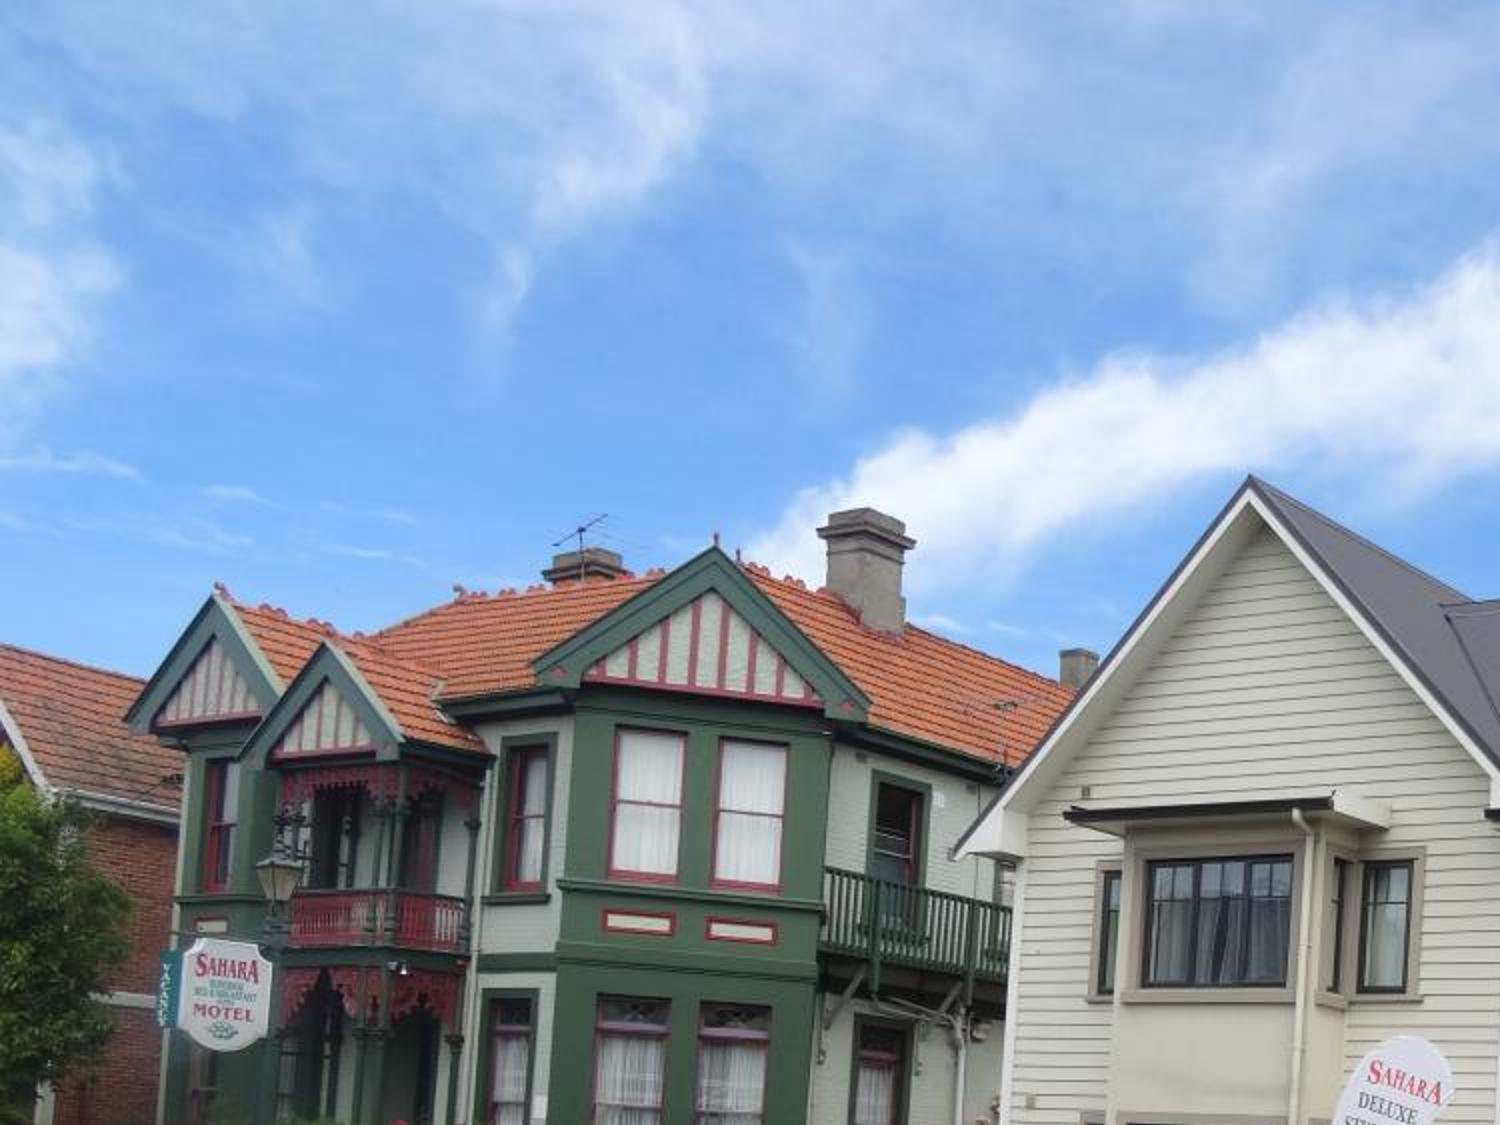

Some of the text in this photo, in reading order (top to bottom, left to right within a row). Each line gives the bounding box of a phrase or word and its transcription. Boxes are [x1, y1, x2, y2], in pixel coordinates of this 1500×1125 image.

[195, 953, 259, 985] SAHARA
[192, 1002, 255, 1023] MOTEL
[1367, 1059, 1443, 1107] SAHARA
[1358, 1091, 1419, 1125] DELUXE
